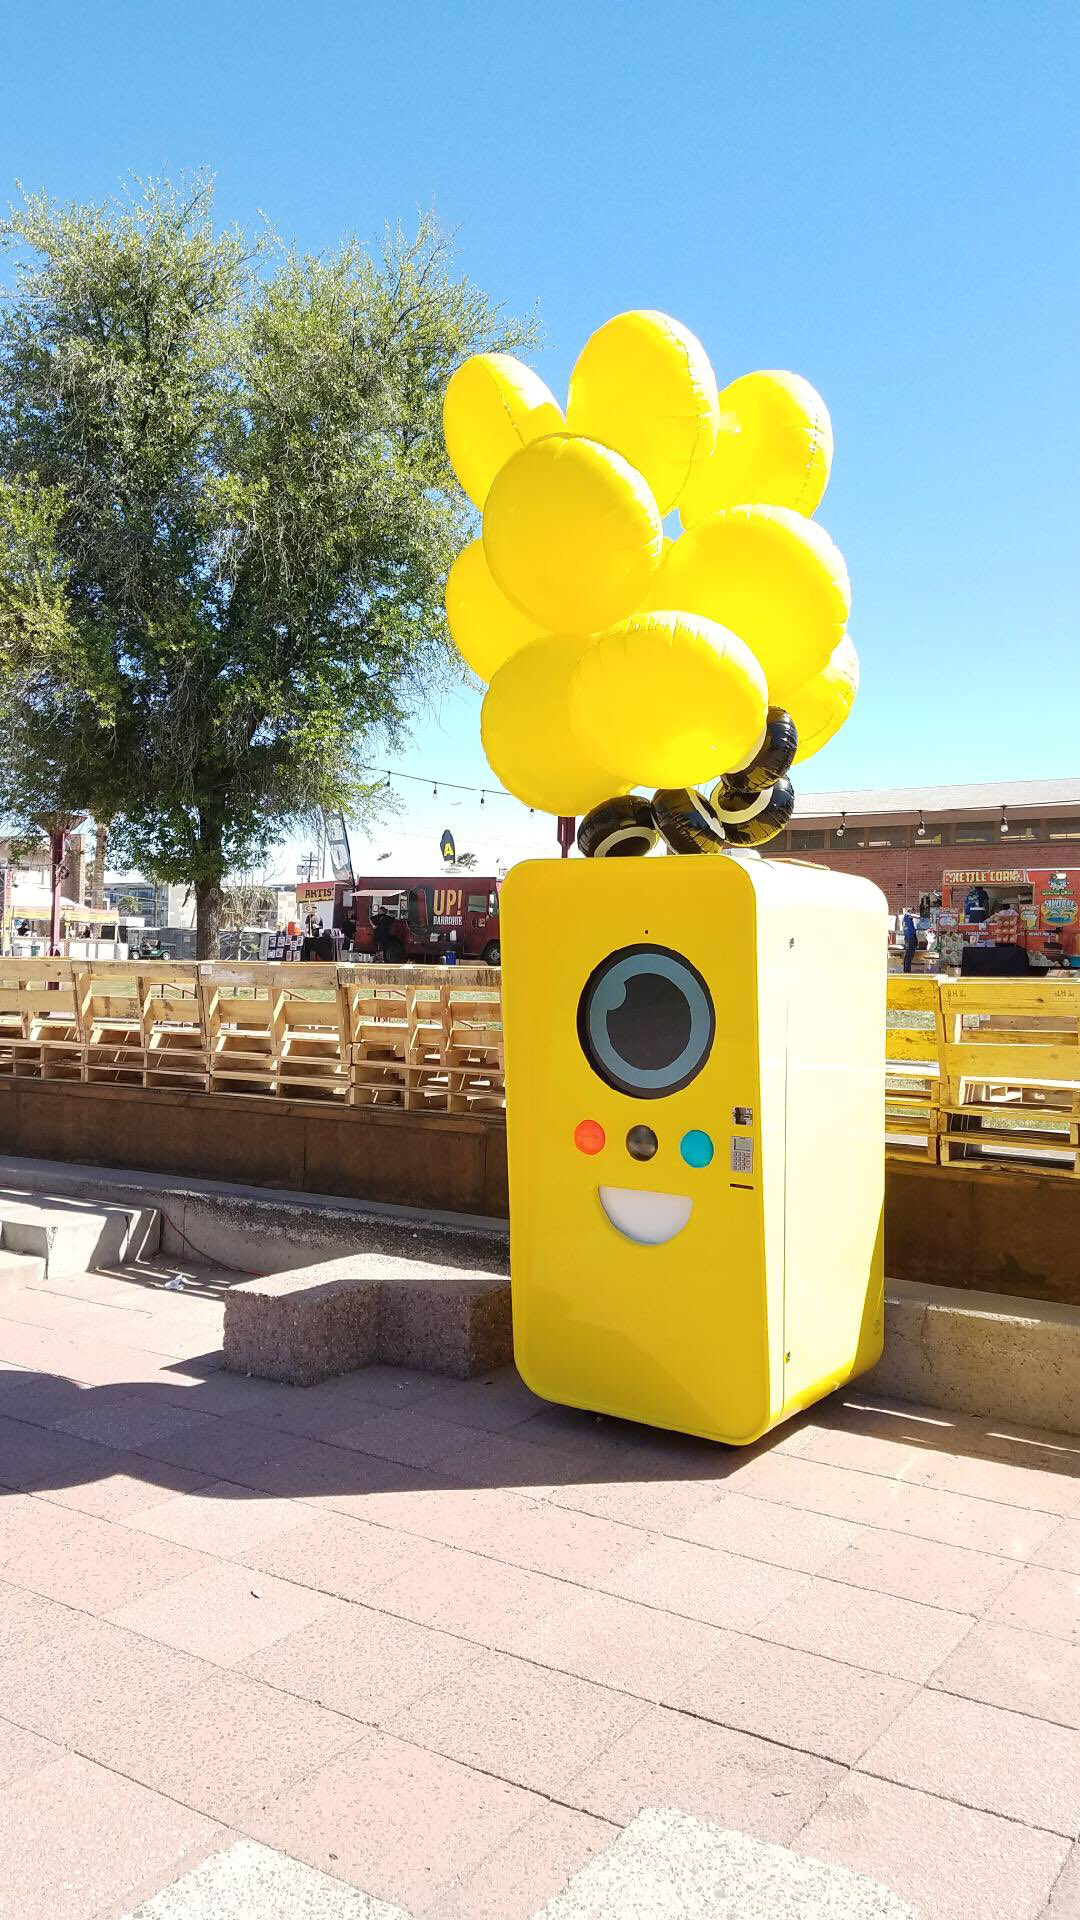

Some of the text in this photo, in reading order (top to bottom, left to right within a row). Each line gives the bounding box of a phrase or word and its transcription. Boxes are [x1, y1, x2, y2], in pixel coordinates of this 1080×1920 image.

[952, 871, 1016, 883] KETTLE CORN
[304, 887, 334, 899] ARTIS
[433, 889, 463, 916] UP!
